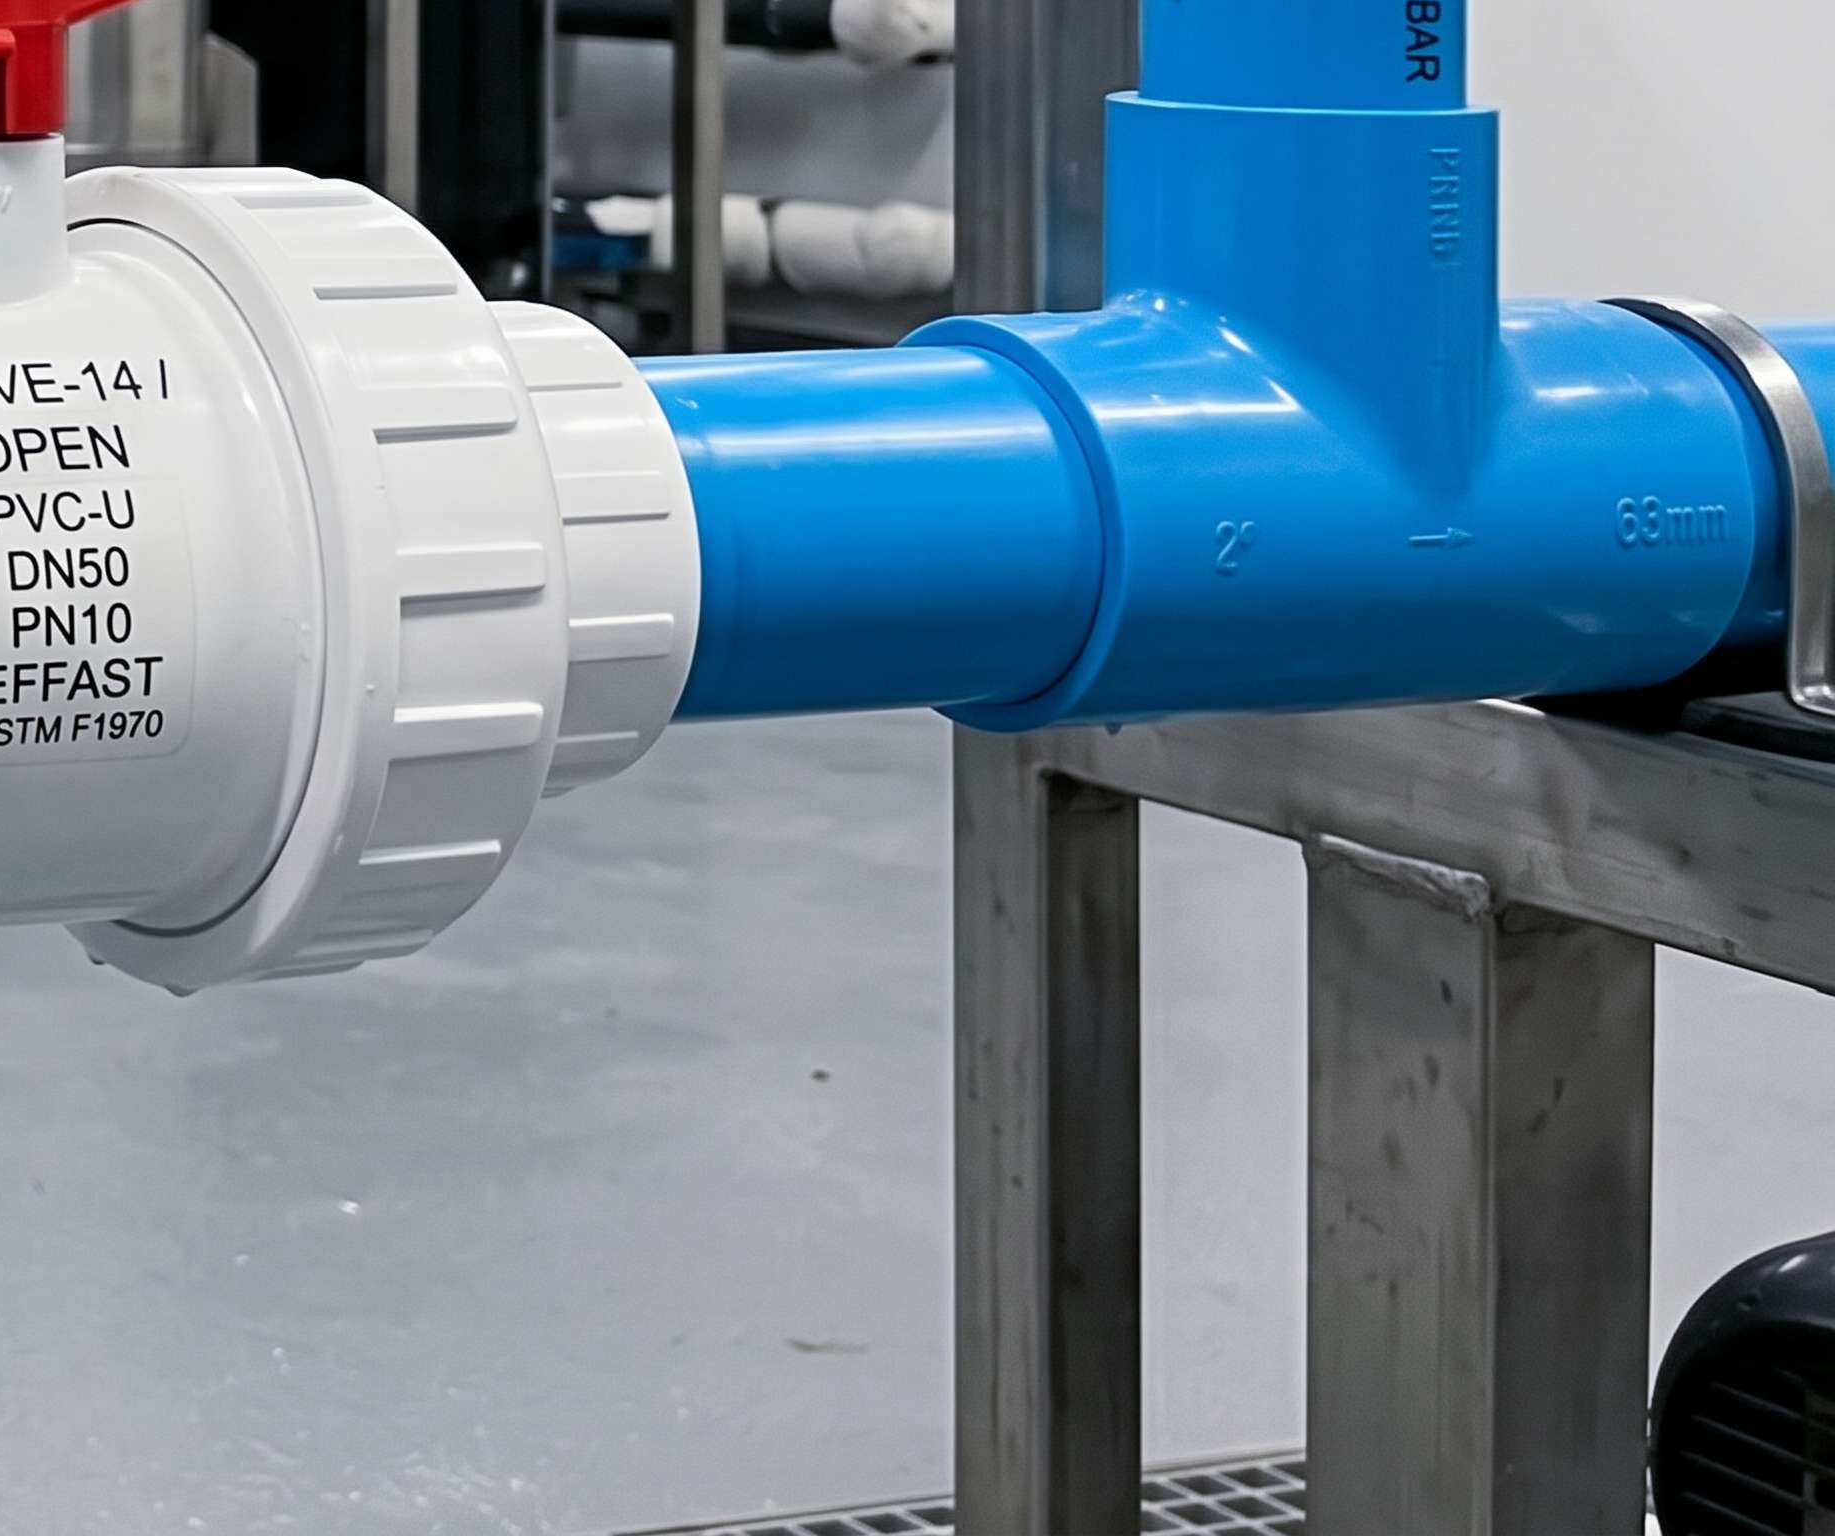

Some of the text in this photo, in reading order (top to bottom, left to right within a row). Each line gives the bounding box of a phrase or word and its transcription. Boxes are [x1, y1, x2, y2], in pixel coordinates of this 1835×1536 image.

[1404, 0, 1441, 83] BAR
[7, 545, 130, 591] DN50
[12, 602, 132, 649] PN10
[71, 709, 164, 742] F1970
